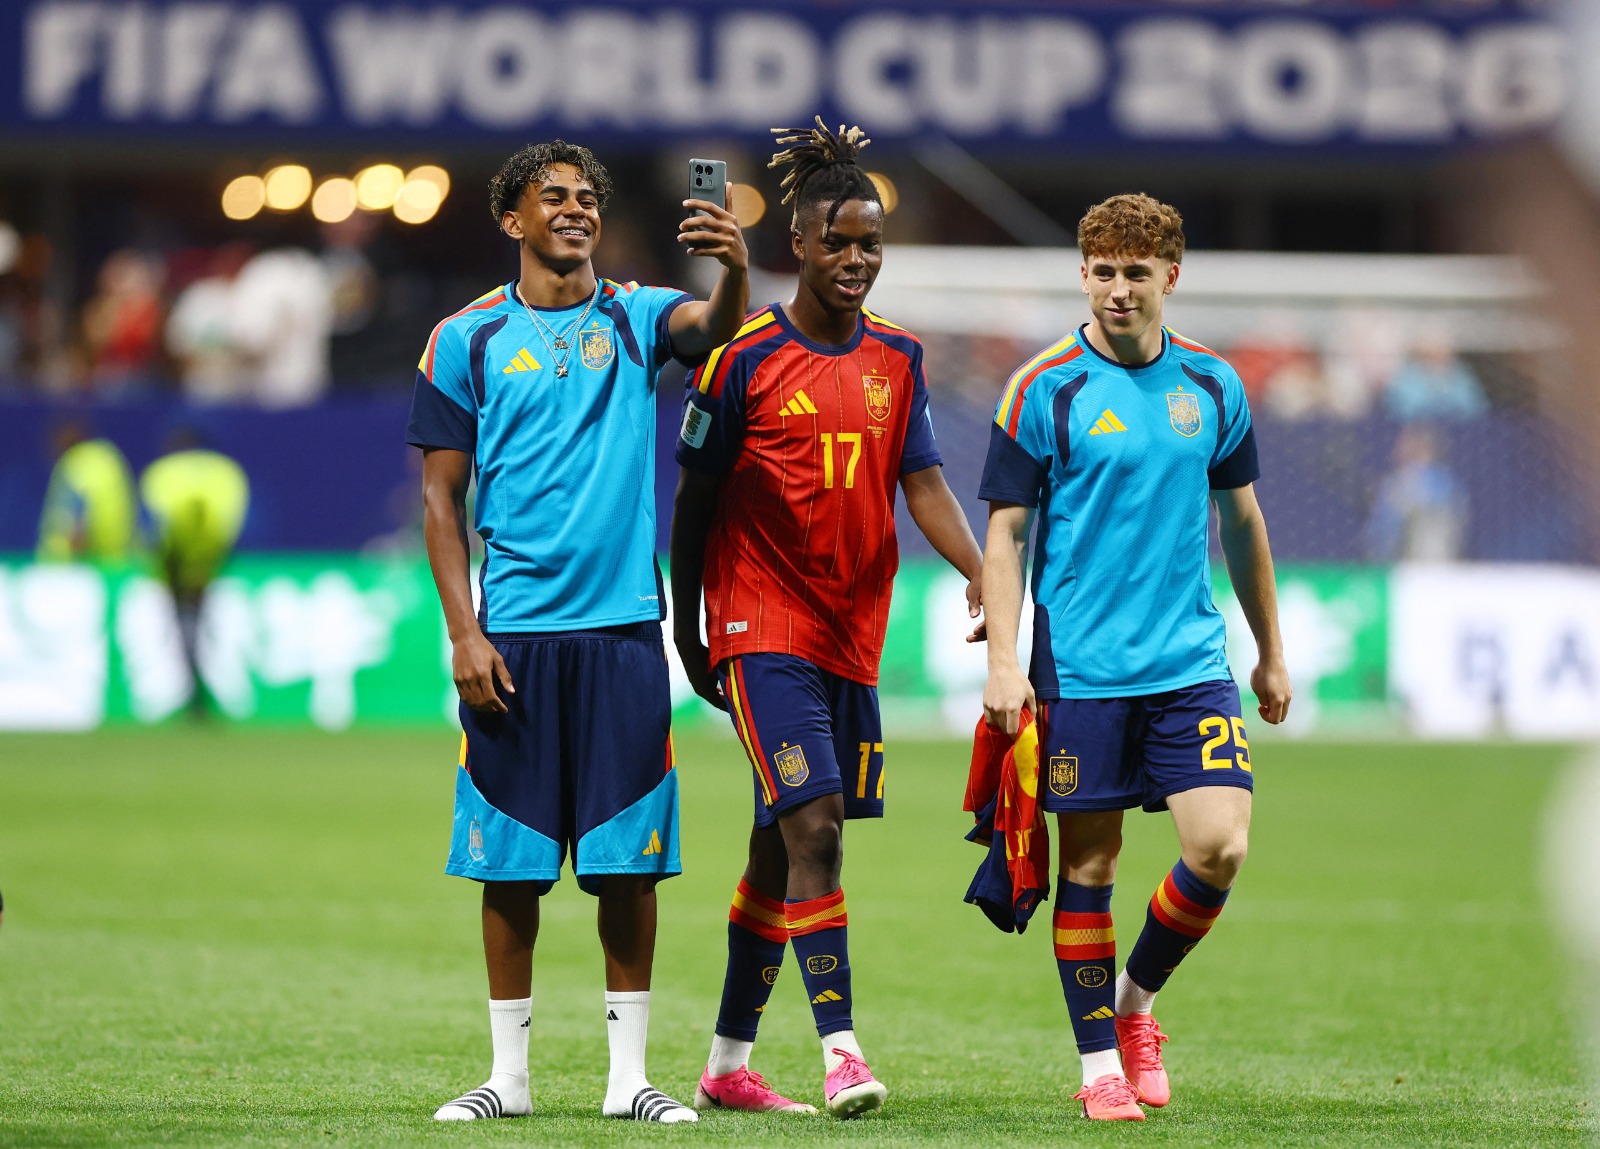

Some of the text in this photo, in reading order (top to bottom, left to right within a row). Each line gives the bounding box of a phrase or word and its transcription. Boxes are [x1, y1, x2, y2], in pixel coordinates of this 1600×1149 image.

[26, 5, 1564, 139] FIFA WORLD CUP 2026
[820, 433, 862, 489] 17
[857, 742, 885, 800] 17
[1198, 716, 1251, 773] 25
